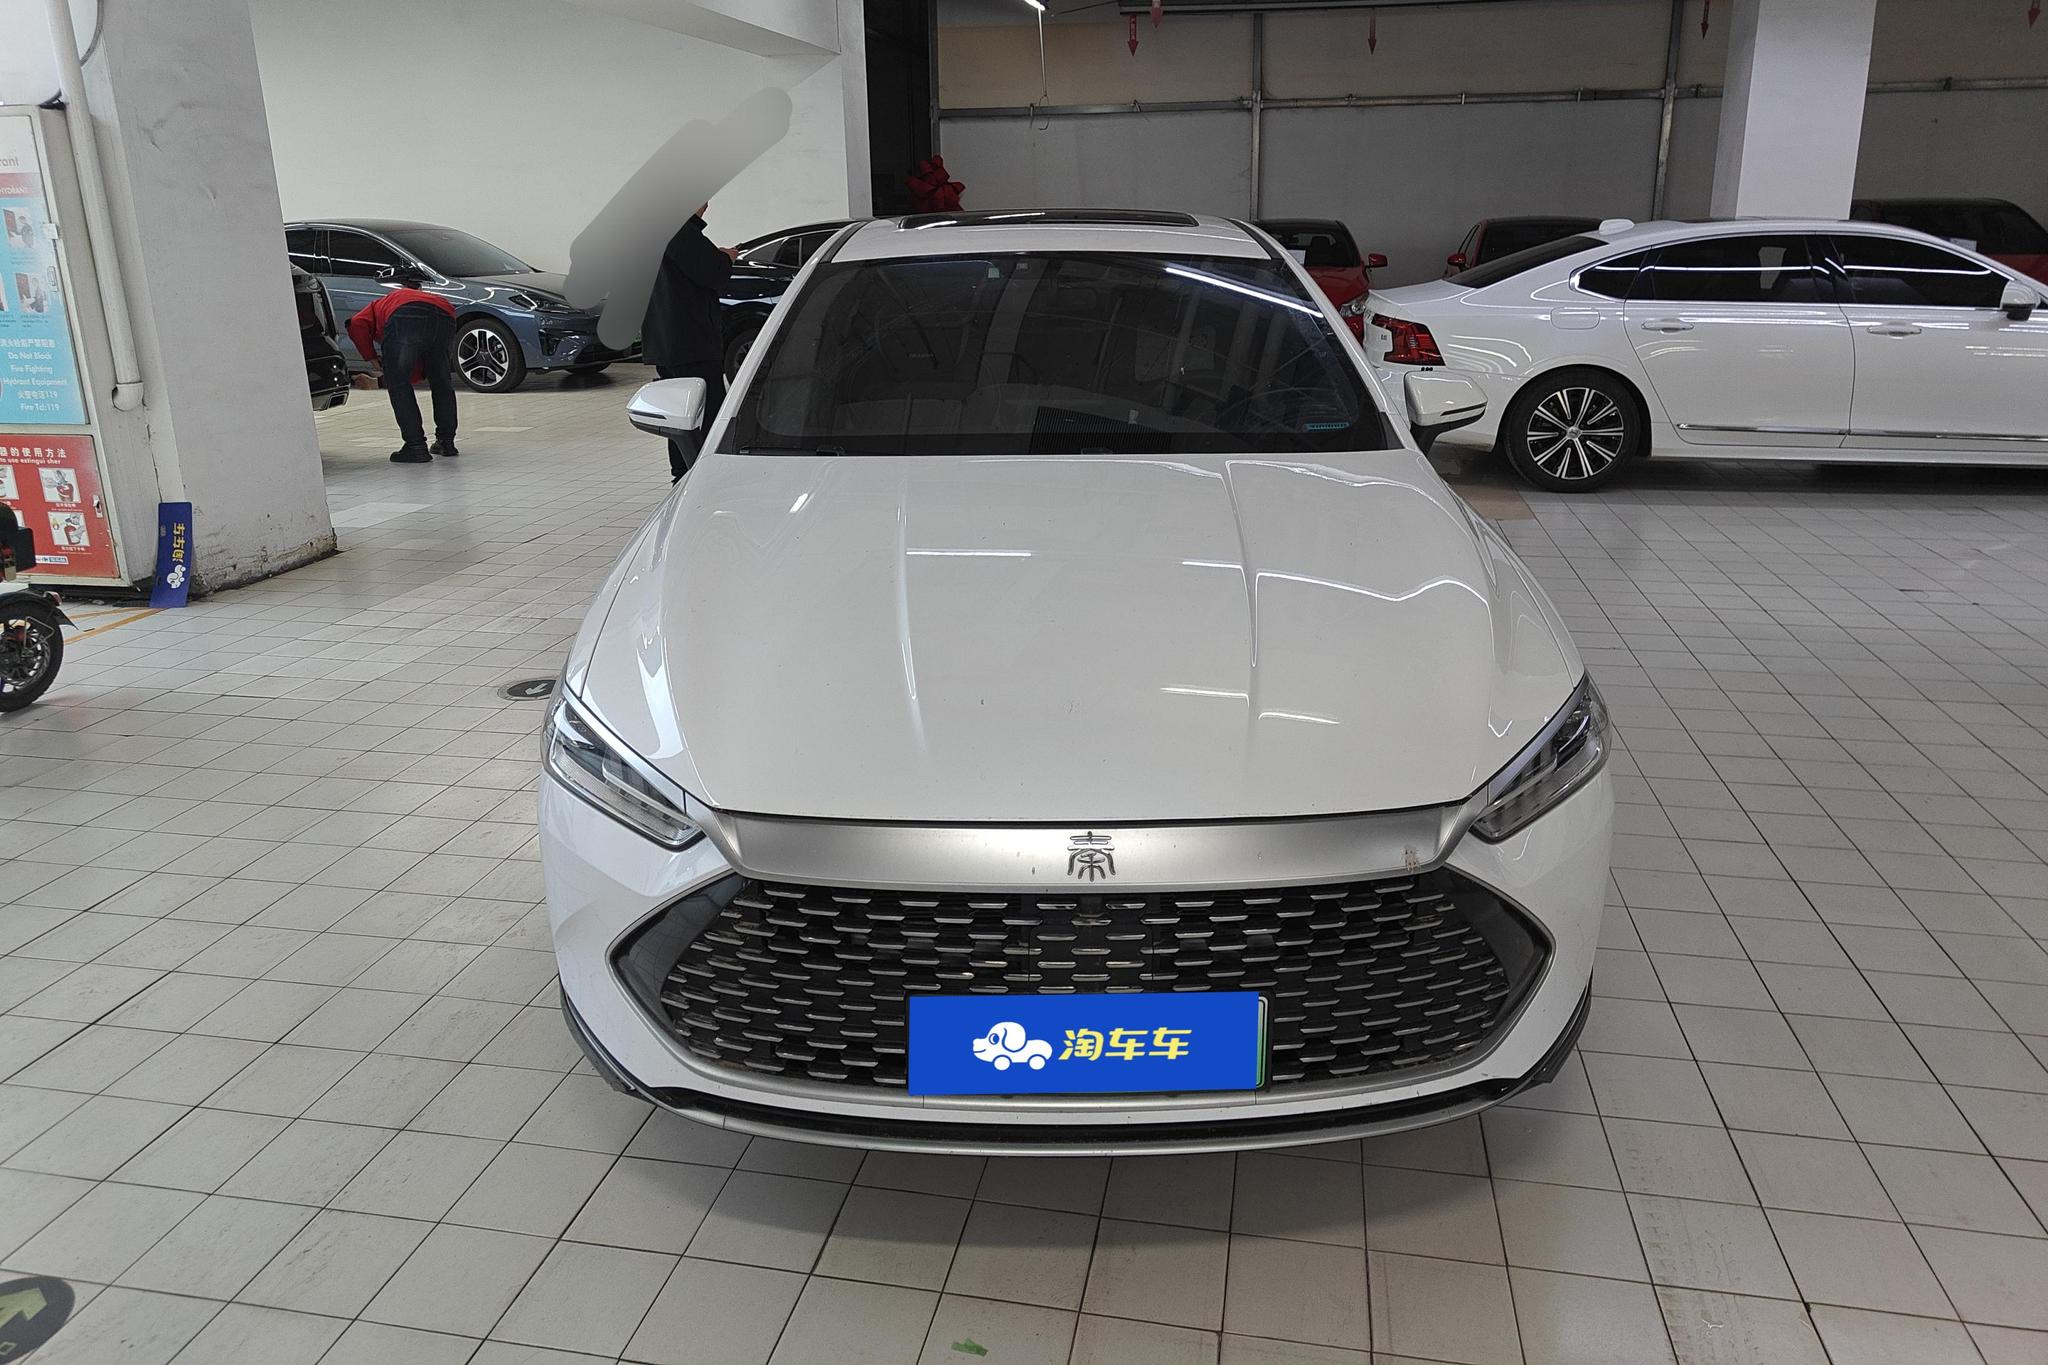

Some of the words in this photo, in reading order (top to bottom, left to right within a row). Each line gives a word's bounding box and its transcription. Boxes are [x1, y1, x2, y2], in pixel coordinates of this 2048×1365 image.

[8, 352, 19, 360] Do
[19, 352, 33, 360] Not
[34, 351, 52, 360] Block
[10, 364, 25, 373] Fire
[24, 364, 53, 375] Fighting
[3, 377, 30, 387] Hydrant
[31, 378, 67, 387] Equipment
[172, 522, 186, 563] 淘车车
